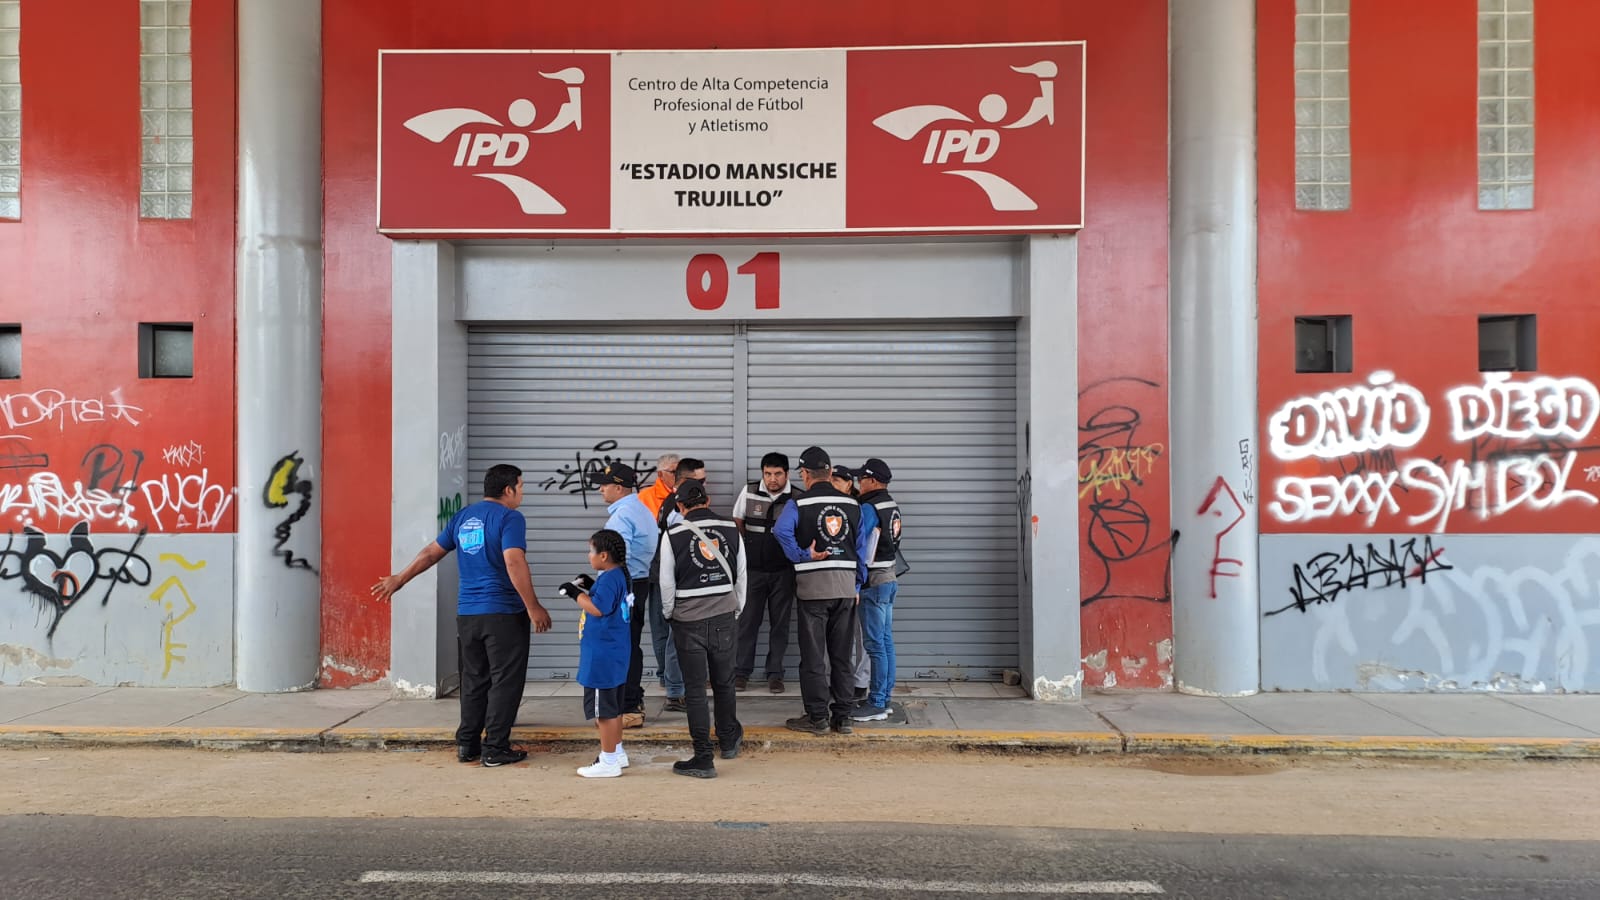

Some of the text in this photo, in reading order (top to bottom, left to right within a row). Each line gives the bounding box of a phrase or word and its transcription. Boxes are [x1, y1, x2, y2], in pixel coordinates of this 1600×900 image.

[629, 77, 828, 93] Centro de Alta Competencia
[654, 97, 803, 111] Profesional de Fútbol
[689, 119, 768, 135] y Atletismo
[453, 132, 530, 167] IPD
[922, 128, 1001, 164] IPD
[727, 163, 836, 179] MANSICHE
[686, 252, 780, 310] 01
